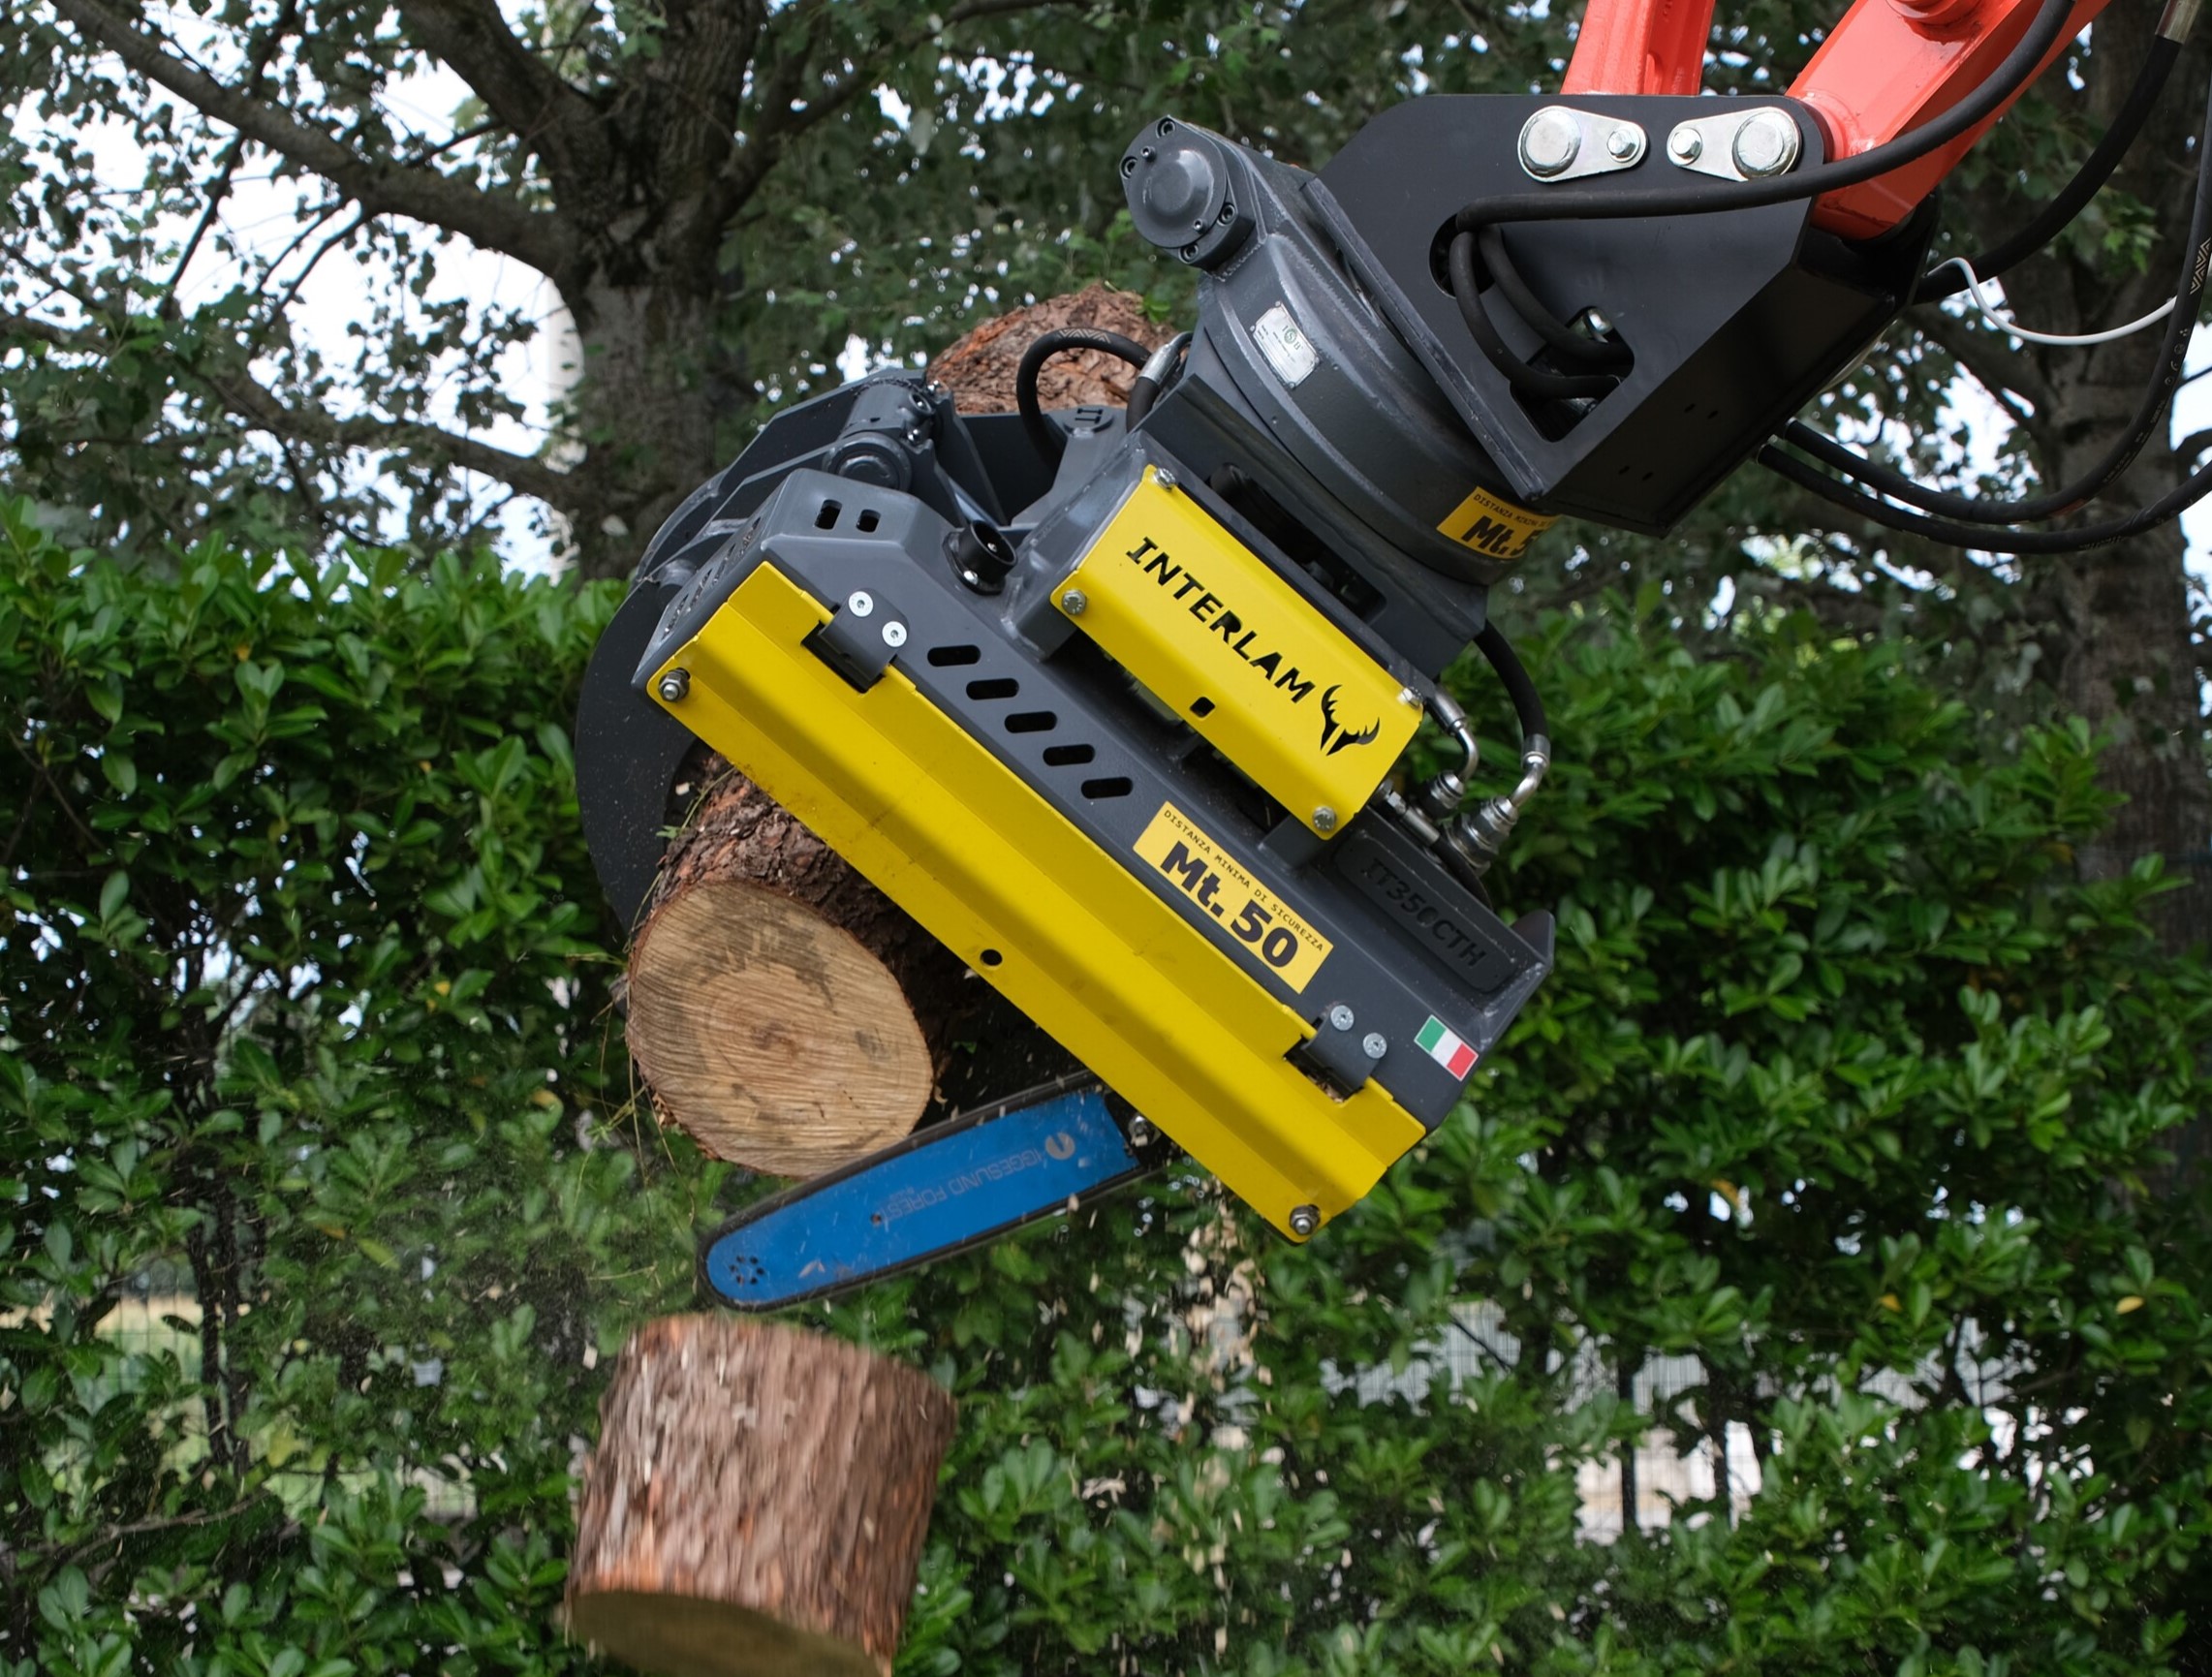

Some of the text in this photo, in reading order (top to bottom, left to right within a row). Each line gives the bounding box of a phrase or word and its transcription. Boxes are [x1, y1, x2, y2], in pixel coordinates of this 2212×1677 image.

[1473, 493, 1513, 518] DISTANZA
[1127, 537, 1316, 703] INTERLAM
[1164, 810, 1324, 951] DISTANZA MINIMA DI SICUREZZA
[949, 1148, 1043, 1195] IGGESUND
[880, 1186, 947, 1221] FOREST
